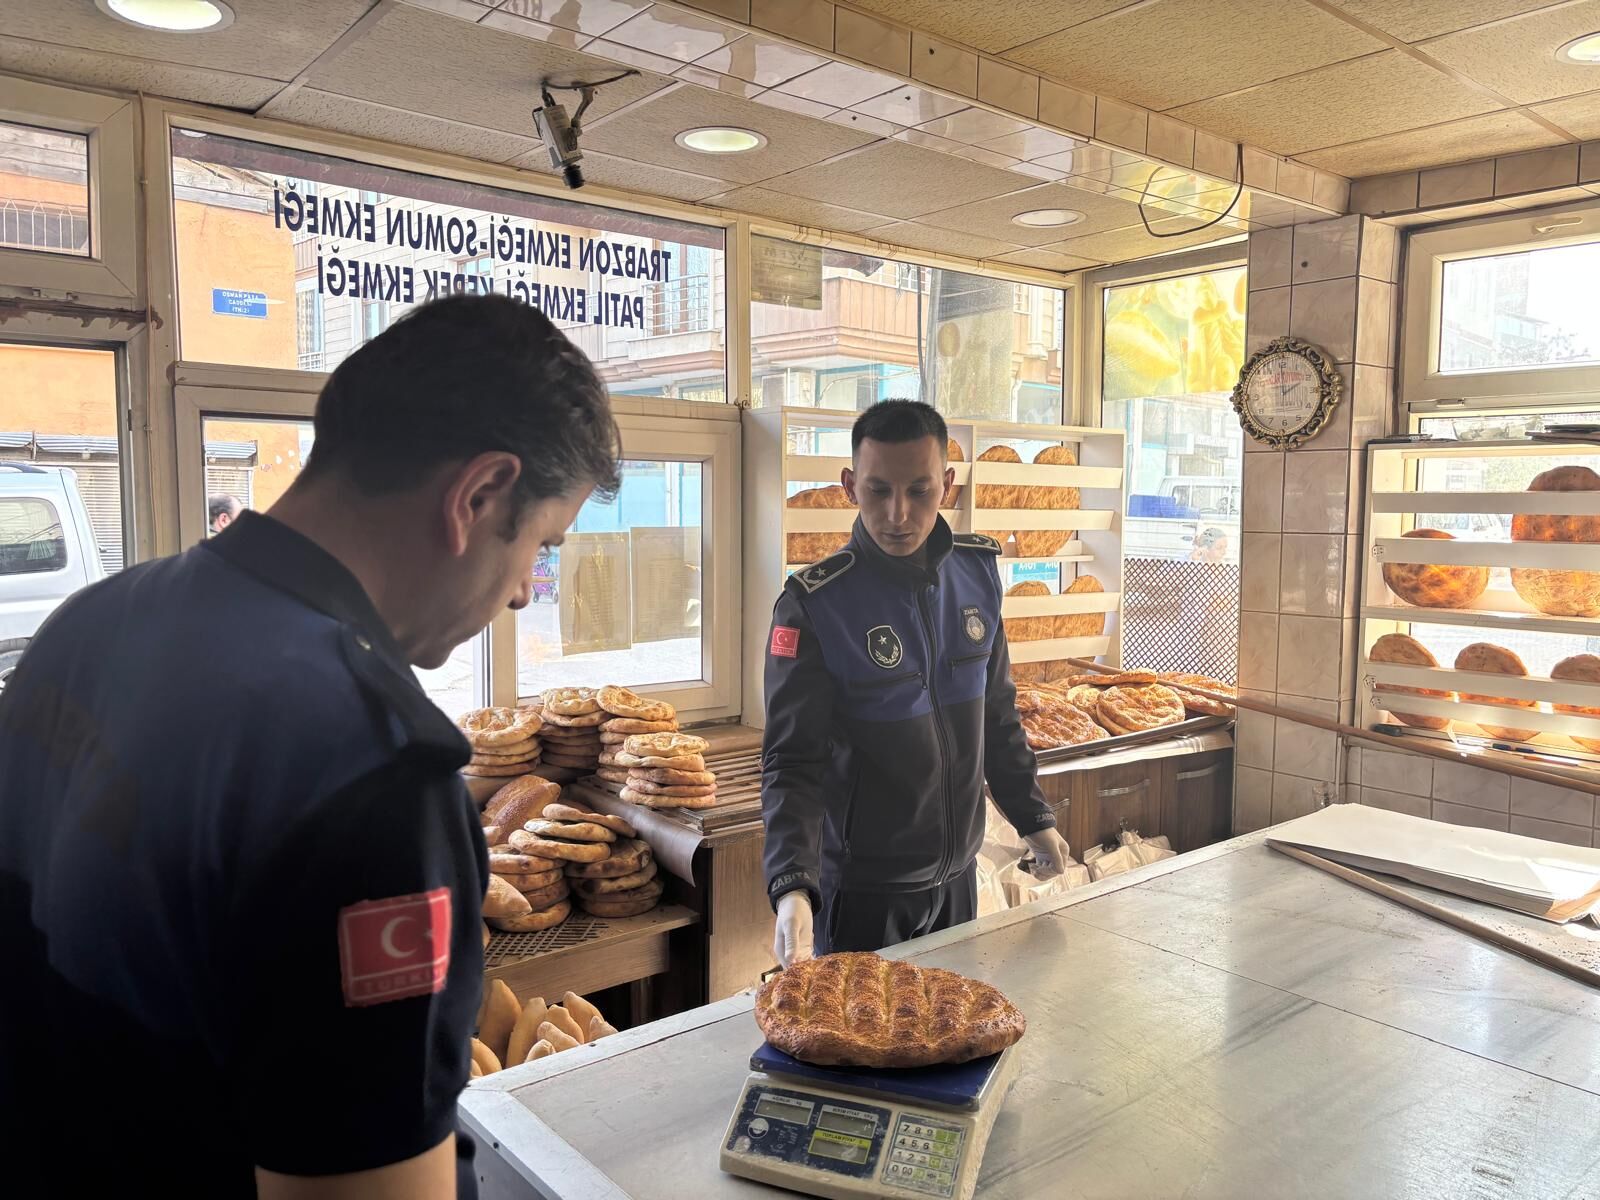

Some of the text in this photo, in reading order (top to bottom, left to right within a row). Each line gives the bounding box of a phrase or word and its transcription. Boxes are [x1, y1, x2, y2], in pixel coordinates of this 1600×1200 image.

[771, 871, 811, 892] ZABITA
[903, 1124, 910, 1132] 7
[914, 1126, 921, 1134] 8
[899, 1137, 906, 1145] 4
[923, 1142, 929, 1150] 6
